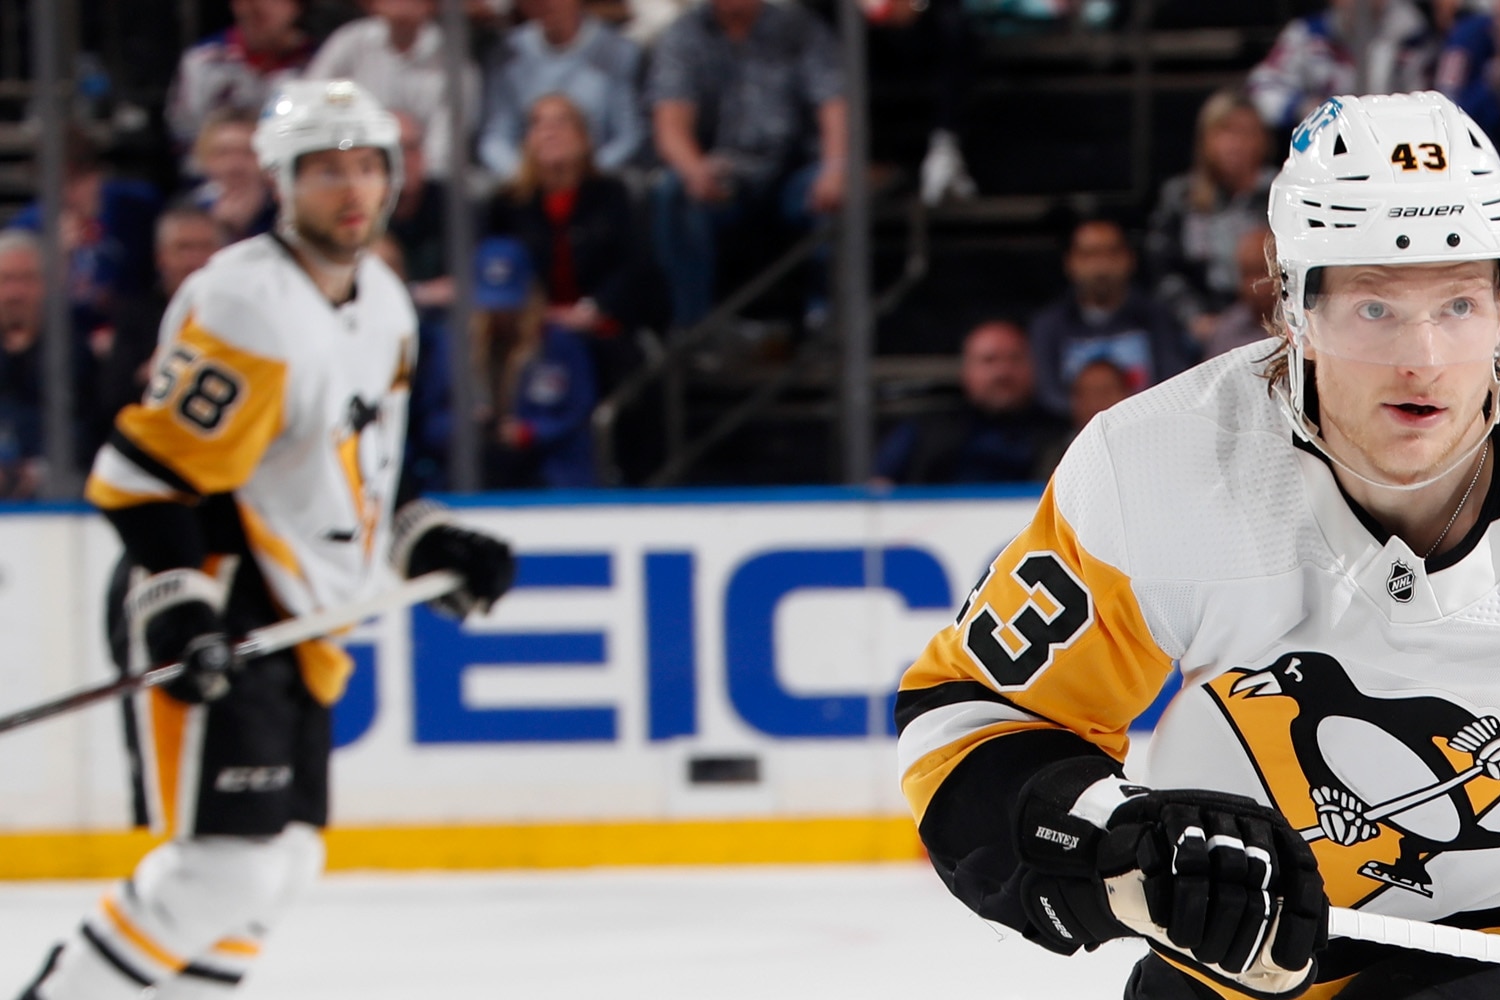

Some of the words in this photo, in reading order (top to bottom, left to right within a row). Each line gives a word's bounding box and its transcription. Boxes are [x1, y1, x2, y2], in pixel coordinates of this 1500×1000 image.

[1391, 142, 1449, 173] 43
[1388, 203, 1465, 218] BAUER
[141, 342, 251, 441] 58
[1390, 575, 1412, 591] NHL
[954, 550, 1095, 693] 3
[1035, 825, 1081, 850] HEINEN
[1040, 895, 1073, 939] BAUER
